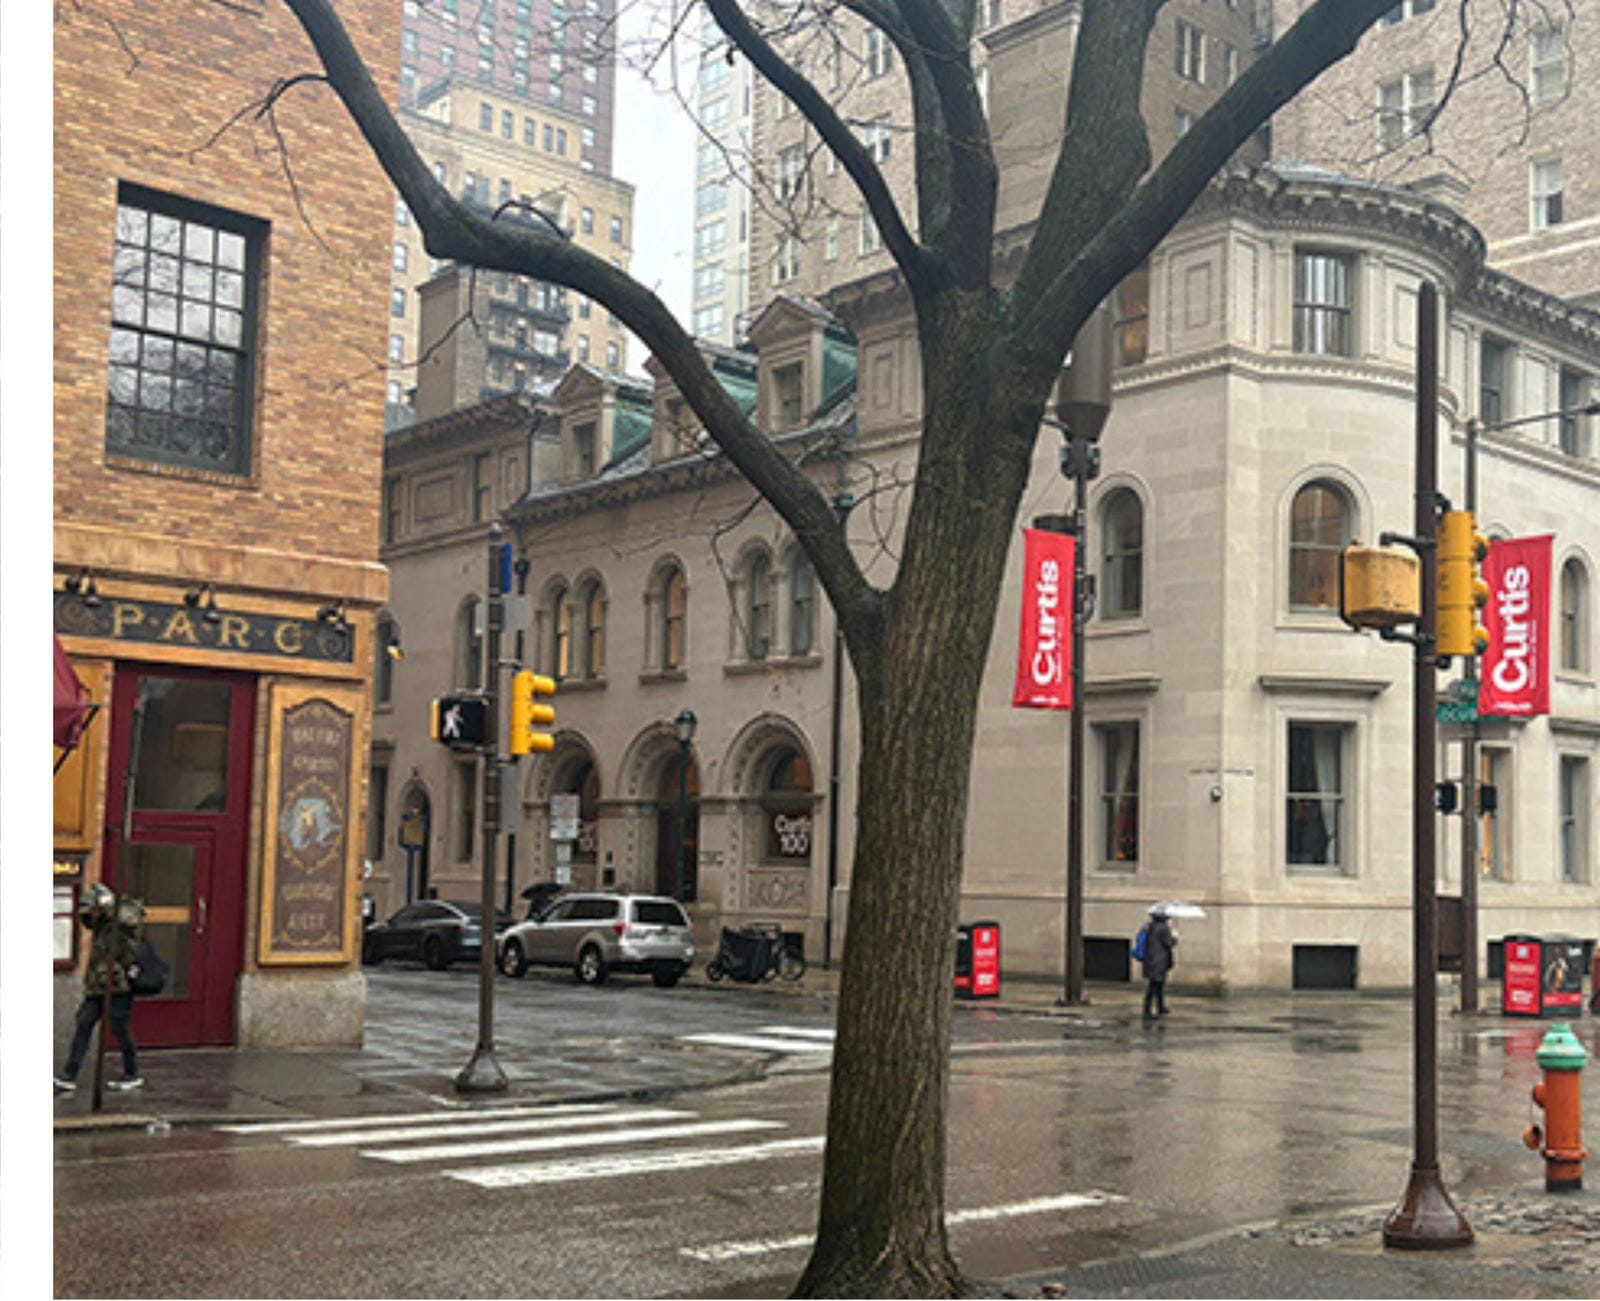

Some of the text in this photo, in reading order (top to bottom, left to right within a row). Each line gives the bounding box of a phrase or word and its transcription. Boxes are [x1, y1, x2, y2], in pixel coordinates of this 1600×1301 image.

[1032, 560, 1059, 685] Curtis
[1492, 565, 1530, 692] Curtis
[780, 833, 808, 854] 100
